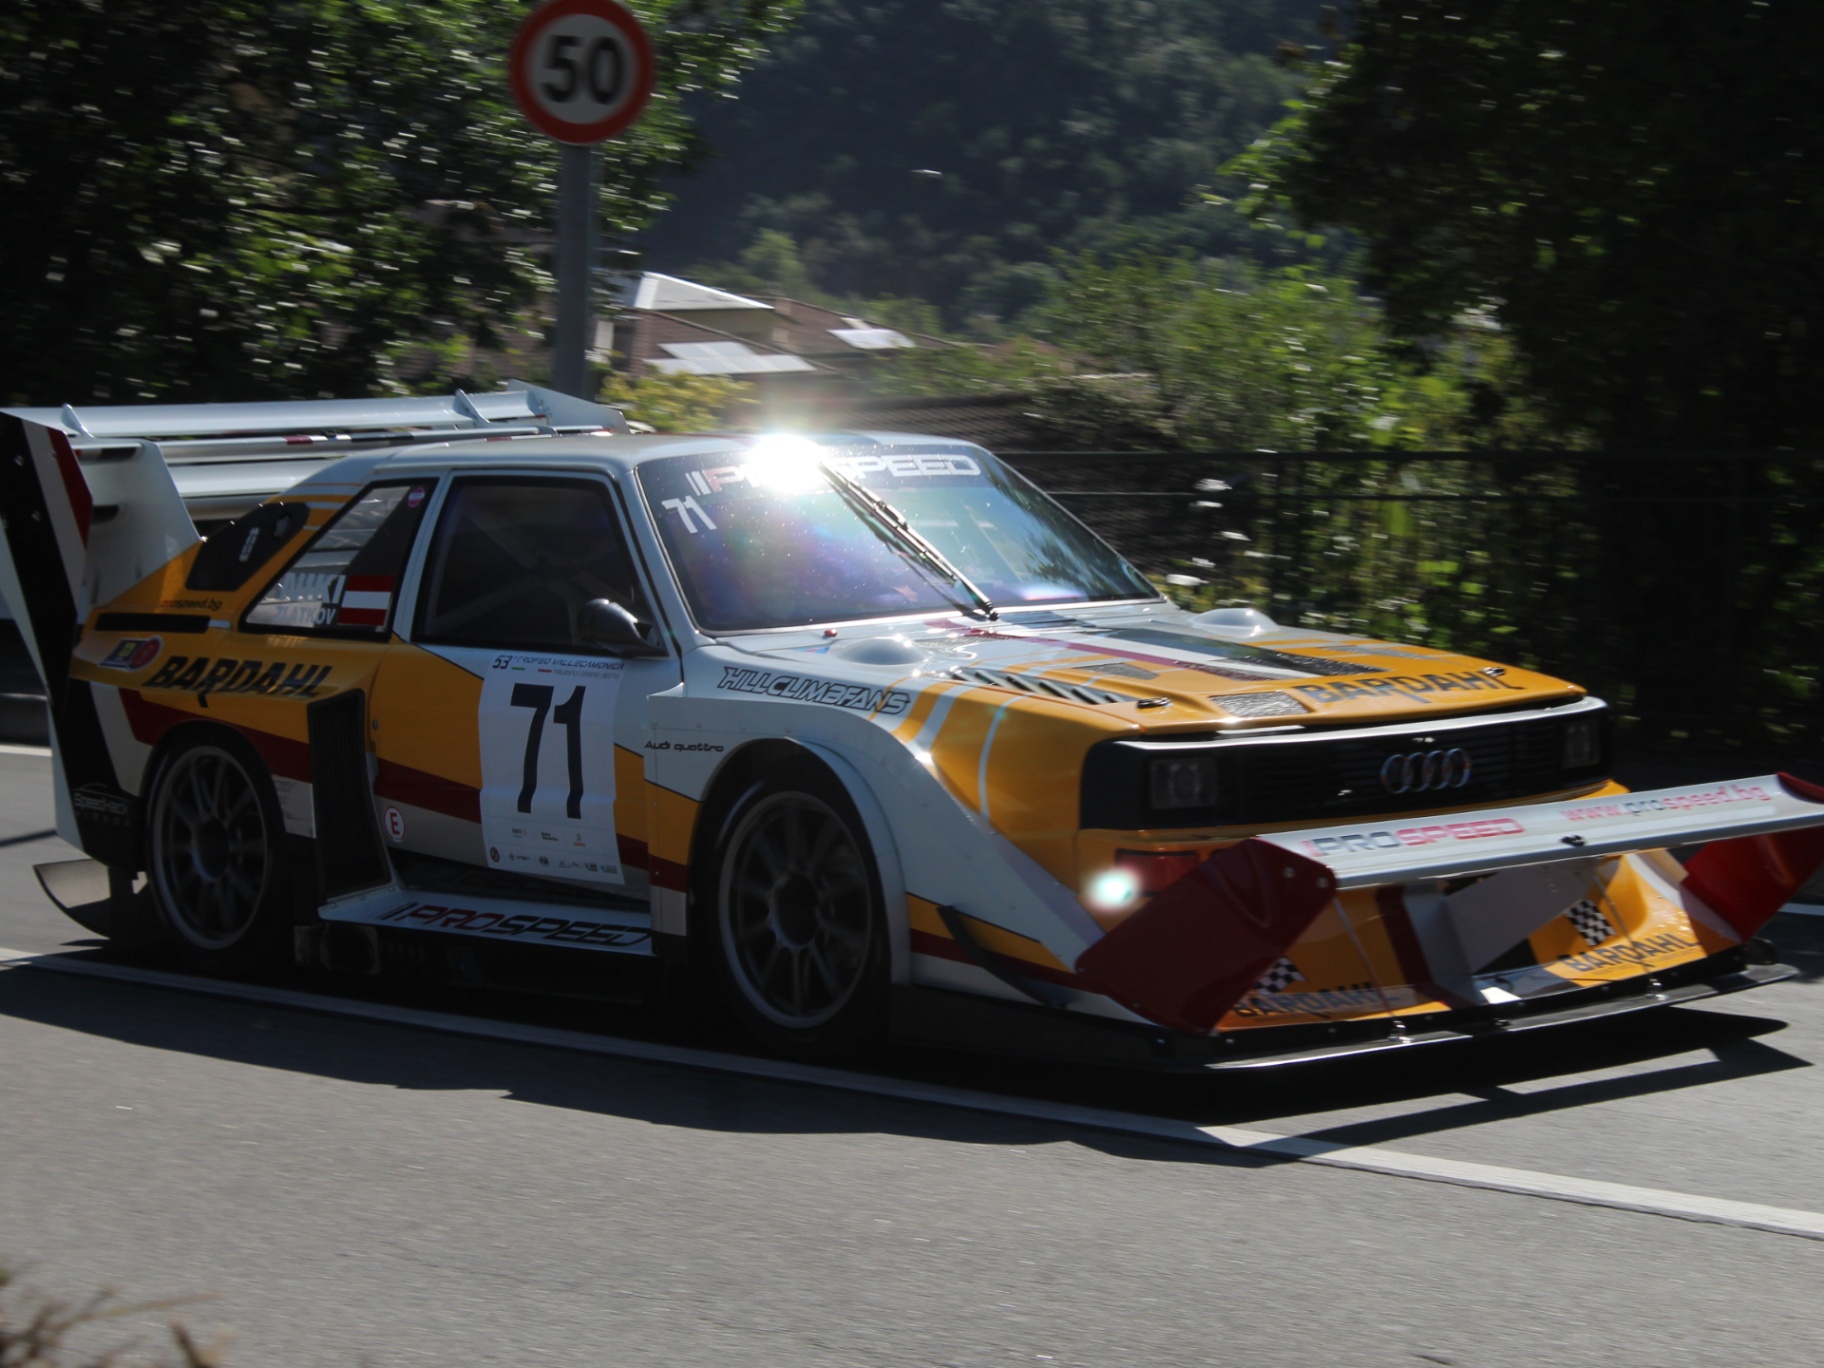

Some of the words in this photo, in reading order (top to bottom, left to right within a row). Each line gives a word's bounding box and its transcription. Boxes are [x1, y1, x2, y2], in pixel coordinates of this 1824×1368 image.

[540, 34, 624, 106] 50
[661, 496, 717, 534] 71
[272, 606, 337, 626] ZLATKOV
[142, 655, 334, 708] BARDAHL
[717, 666, 911, 715] HILLCLIMBFANS
[1291, 670, 1525, 704] BARDAHL
[510, 682, 586, 819] 71
[644, 740, 671, 750] Audi
[673, 742, 724, 752] quattro
[1560, 784, 1773, 823] www.prospeed.bg
[389, 812, 400, 835] E
[393, 904, 652, 947] PROSPEED
[1556, 933, 1702, 972] BARDAHL
